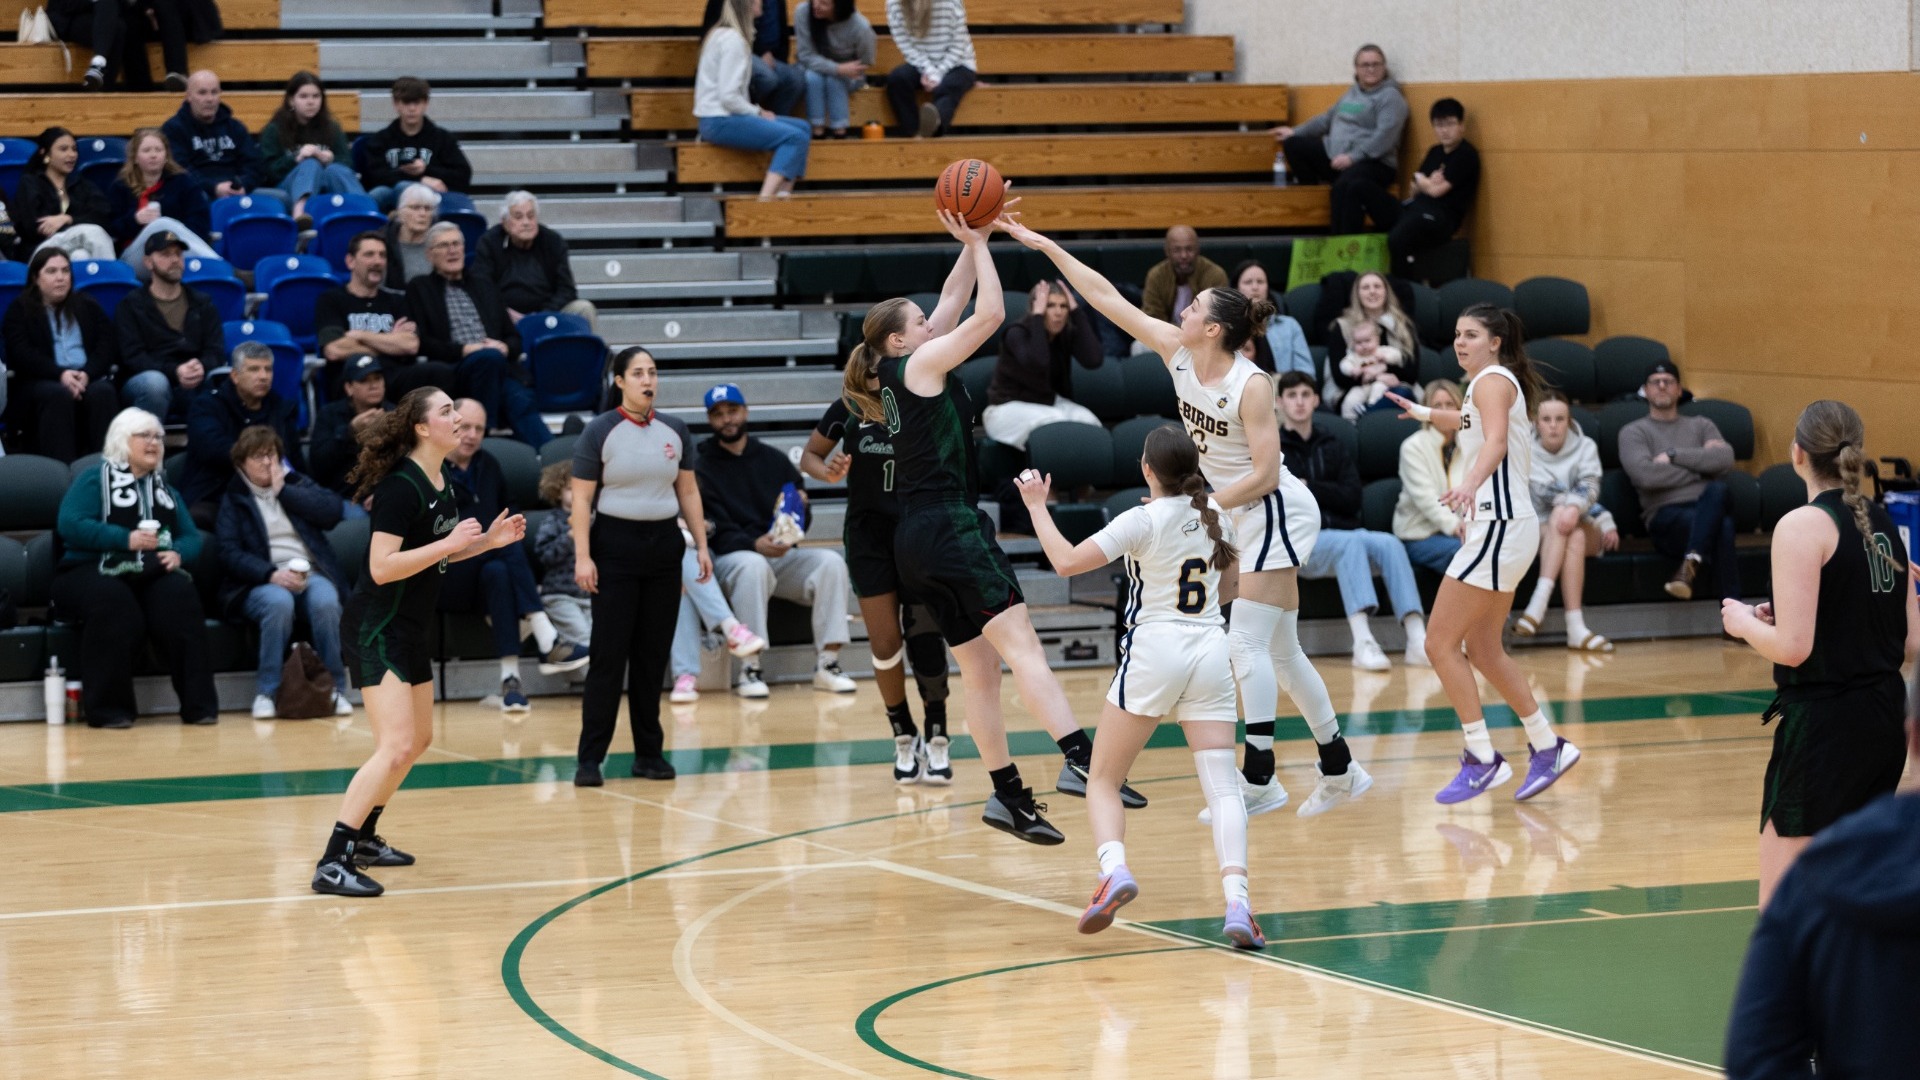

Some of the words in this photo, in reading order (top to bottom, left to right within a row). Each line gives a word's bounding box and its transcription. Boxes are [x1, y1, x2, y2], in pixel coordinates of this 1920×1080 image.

[962, 160, 981, 197] Wilson
[1178, 397, 1228, 437] -BIRDS
[883, 459, 895, 492] 1
[1862, 532, 1895, 593] 10
[1176, 556, 1208, 616] 6
